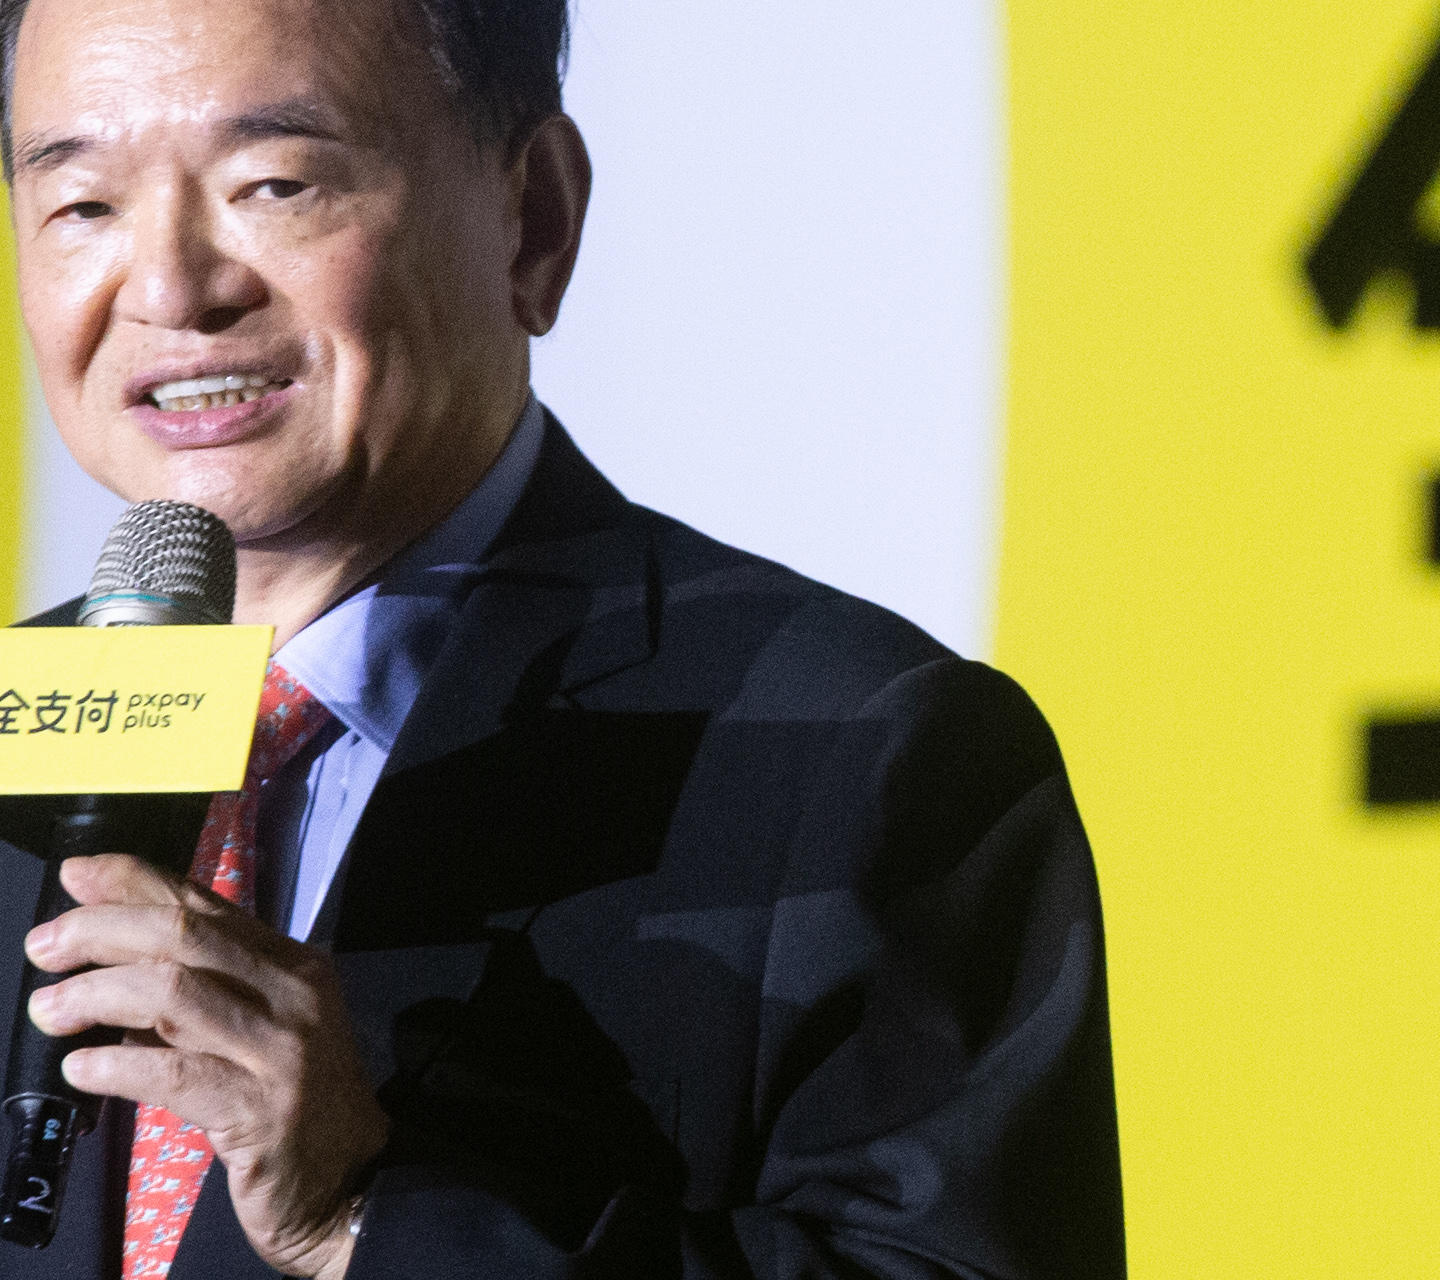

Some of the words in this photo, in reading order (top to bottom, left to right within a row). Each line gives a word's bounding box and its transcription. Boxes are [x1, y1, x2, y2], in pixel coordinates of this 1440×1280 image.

[127, 692, 207, 712] pxpay
[122, 710, 172, 733] plus
[18, 1176, 53, 1214] 2
